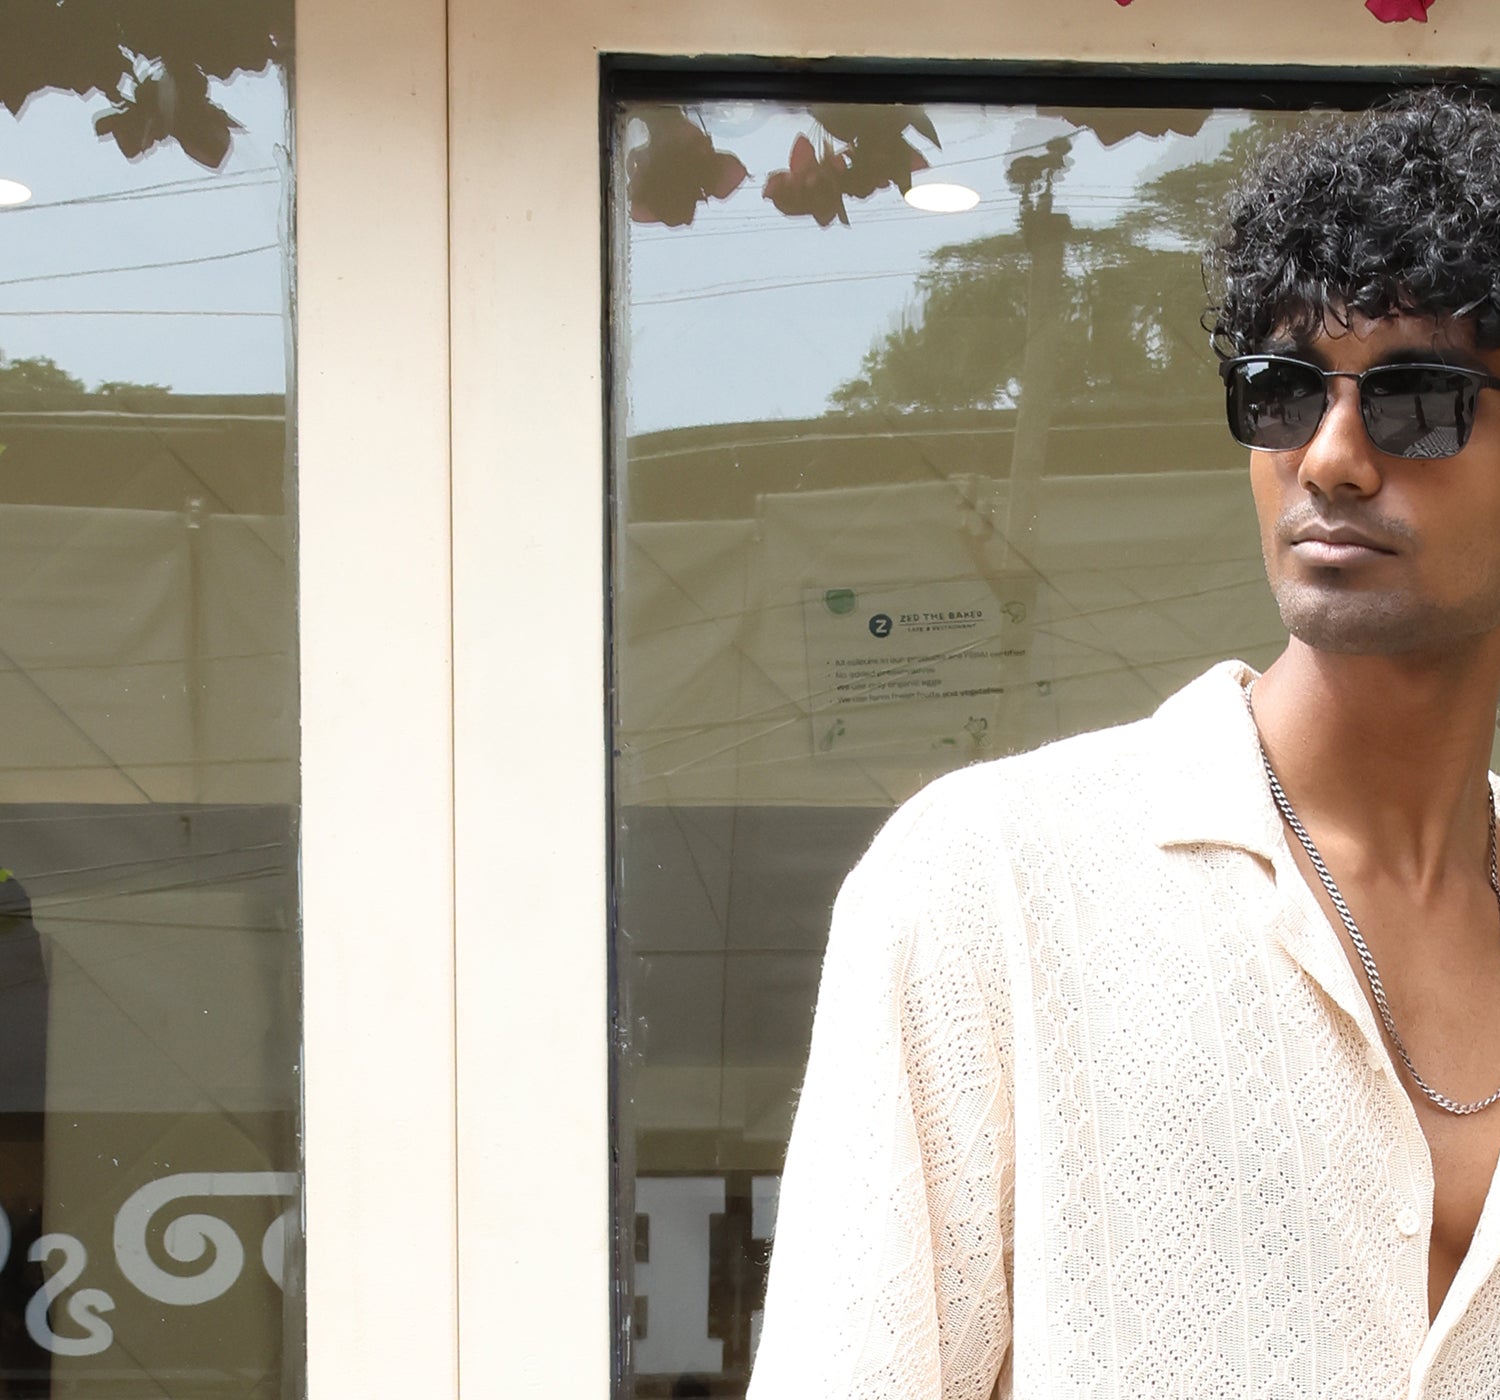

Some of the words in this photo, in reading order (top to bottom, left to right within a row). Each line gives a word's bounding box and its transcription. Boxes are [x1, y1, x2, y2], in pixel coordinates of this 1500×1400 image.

[900, 614, 919, 622] ZED
[922, 612, 944, 620] THE
[876, 619, 888, 633] Z
